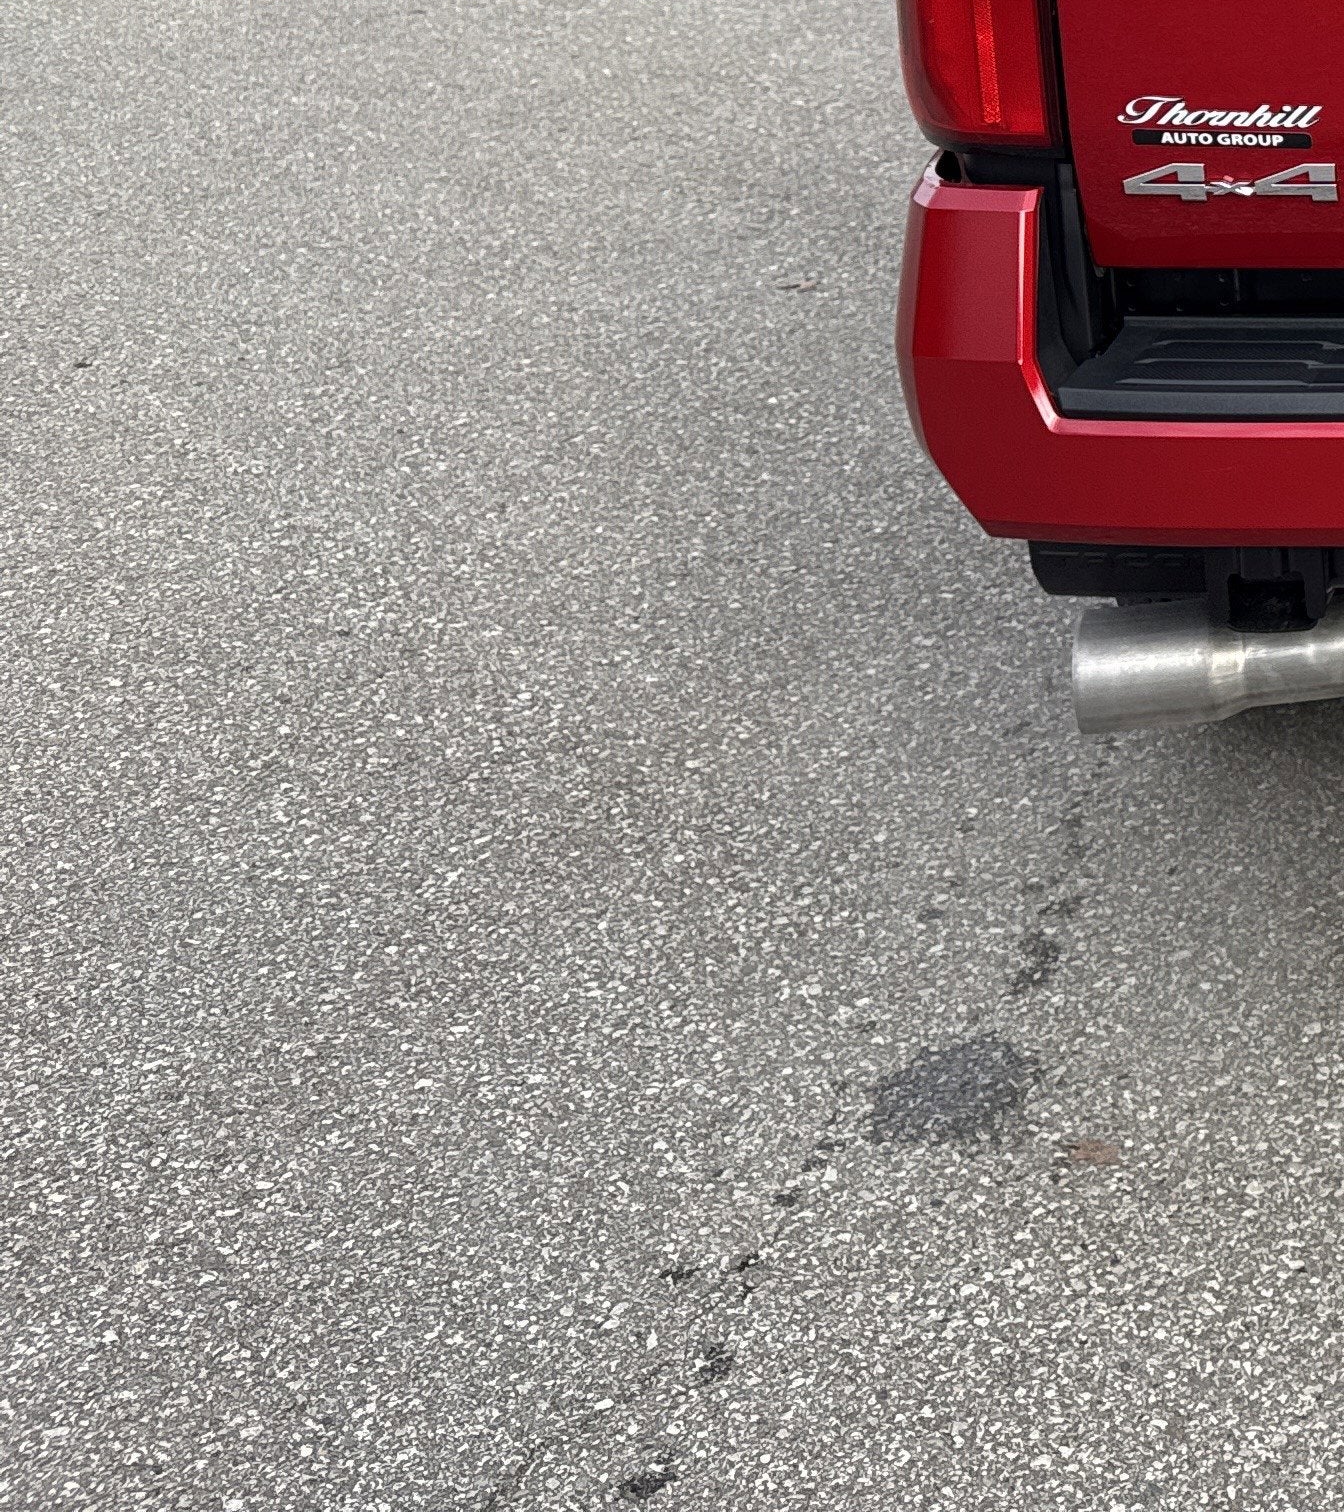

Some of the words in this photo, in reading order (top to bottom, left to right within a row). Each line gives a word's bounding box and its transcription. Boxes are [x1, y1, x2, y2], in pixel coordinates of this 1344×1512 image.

[1117, 96, 1322, 128] Thornhill
[1161, 132, 1213, 145] AUTO
[1217, 133, 1283, 147] GROUP
[1123, 163, 1338, 201] 4x4
